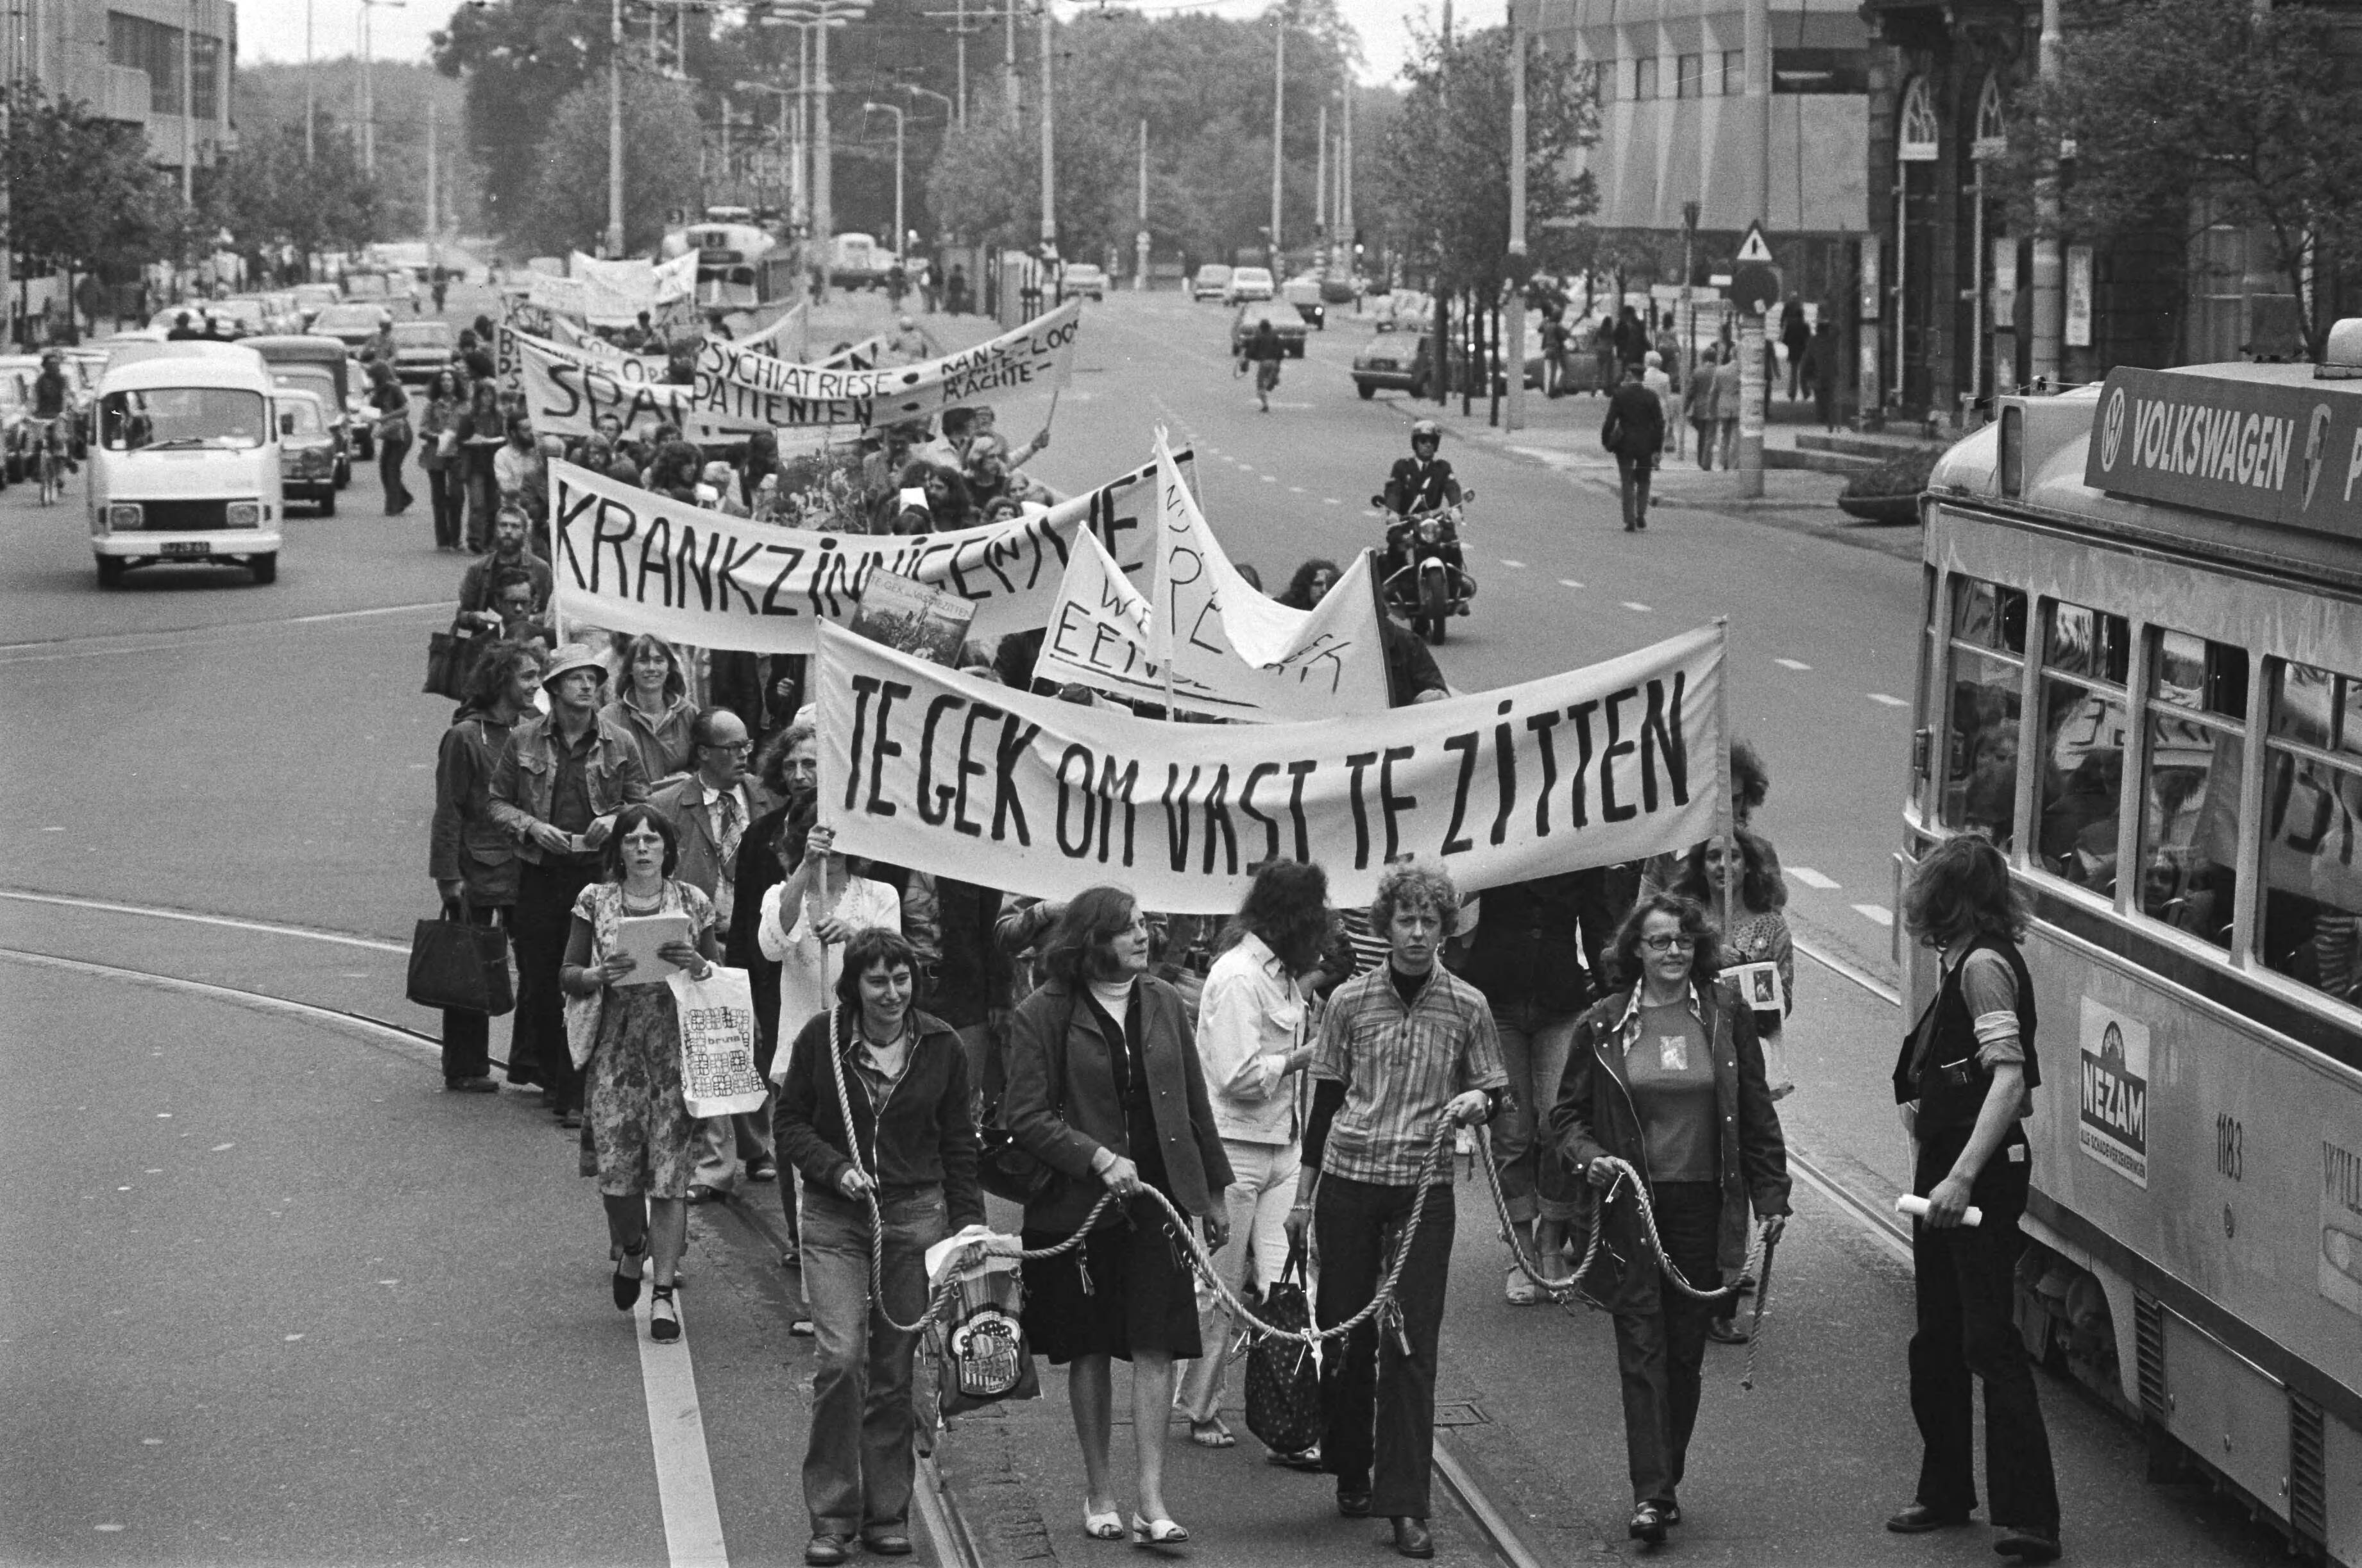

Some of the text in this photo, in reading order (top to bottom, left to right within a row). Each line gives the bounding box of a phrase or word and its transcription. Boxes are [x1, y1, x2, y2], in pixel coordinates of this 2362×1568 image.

[2132, 399, 2295, 491] VOLKSWAGEN
[844, 674, 912, 817] TE
[917, 693, 1042, 847] GEK
[1056, 743, 1139, 868] OM
[1162, 760, 1317, 877] VAST
[1347, 745, 1418, 870] TE
[2083, 1059, 2145, 1142] NEZAM
[2216, 1111, 2243, 1182] 1183
